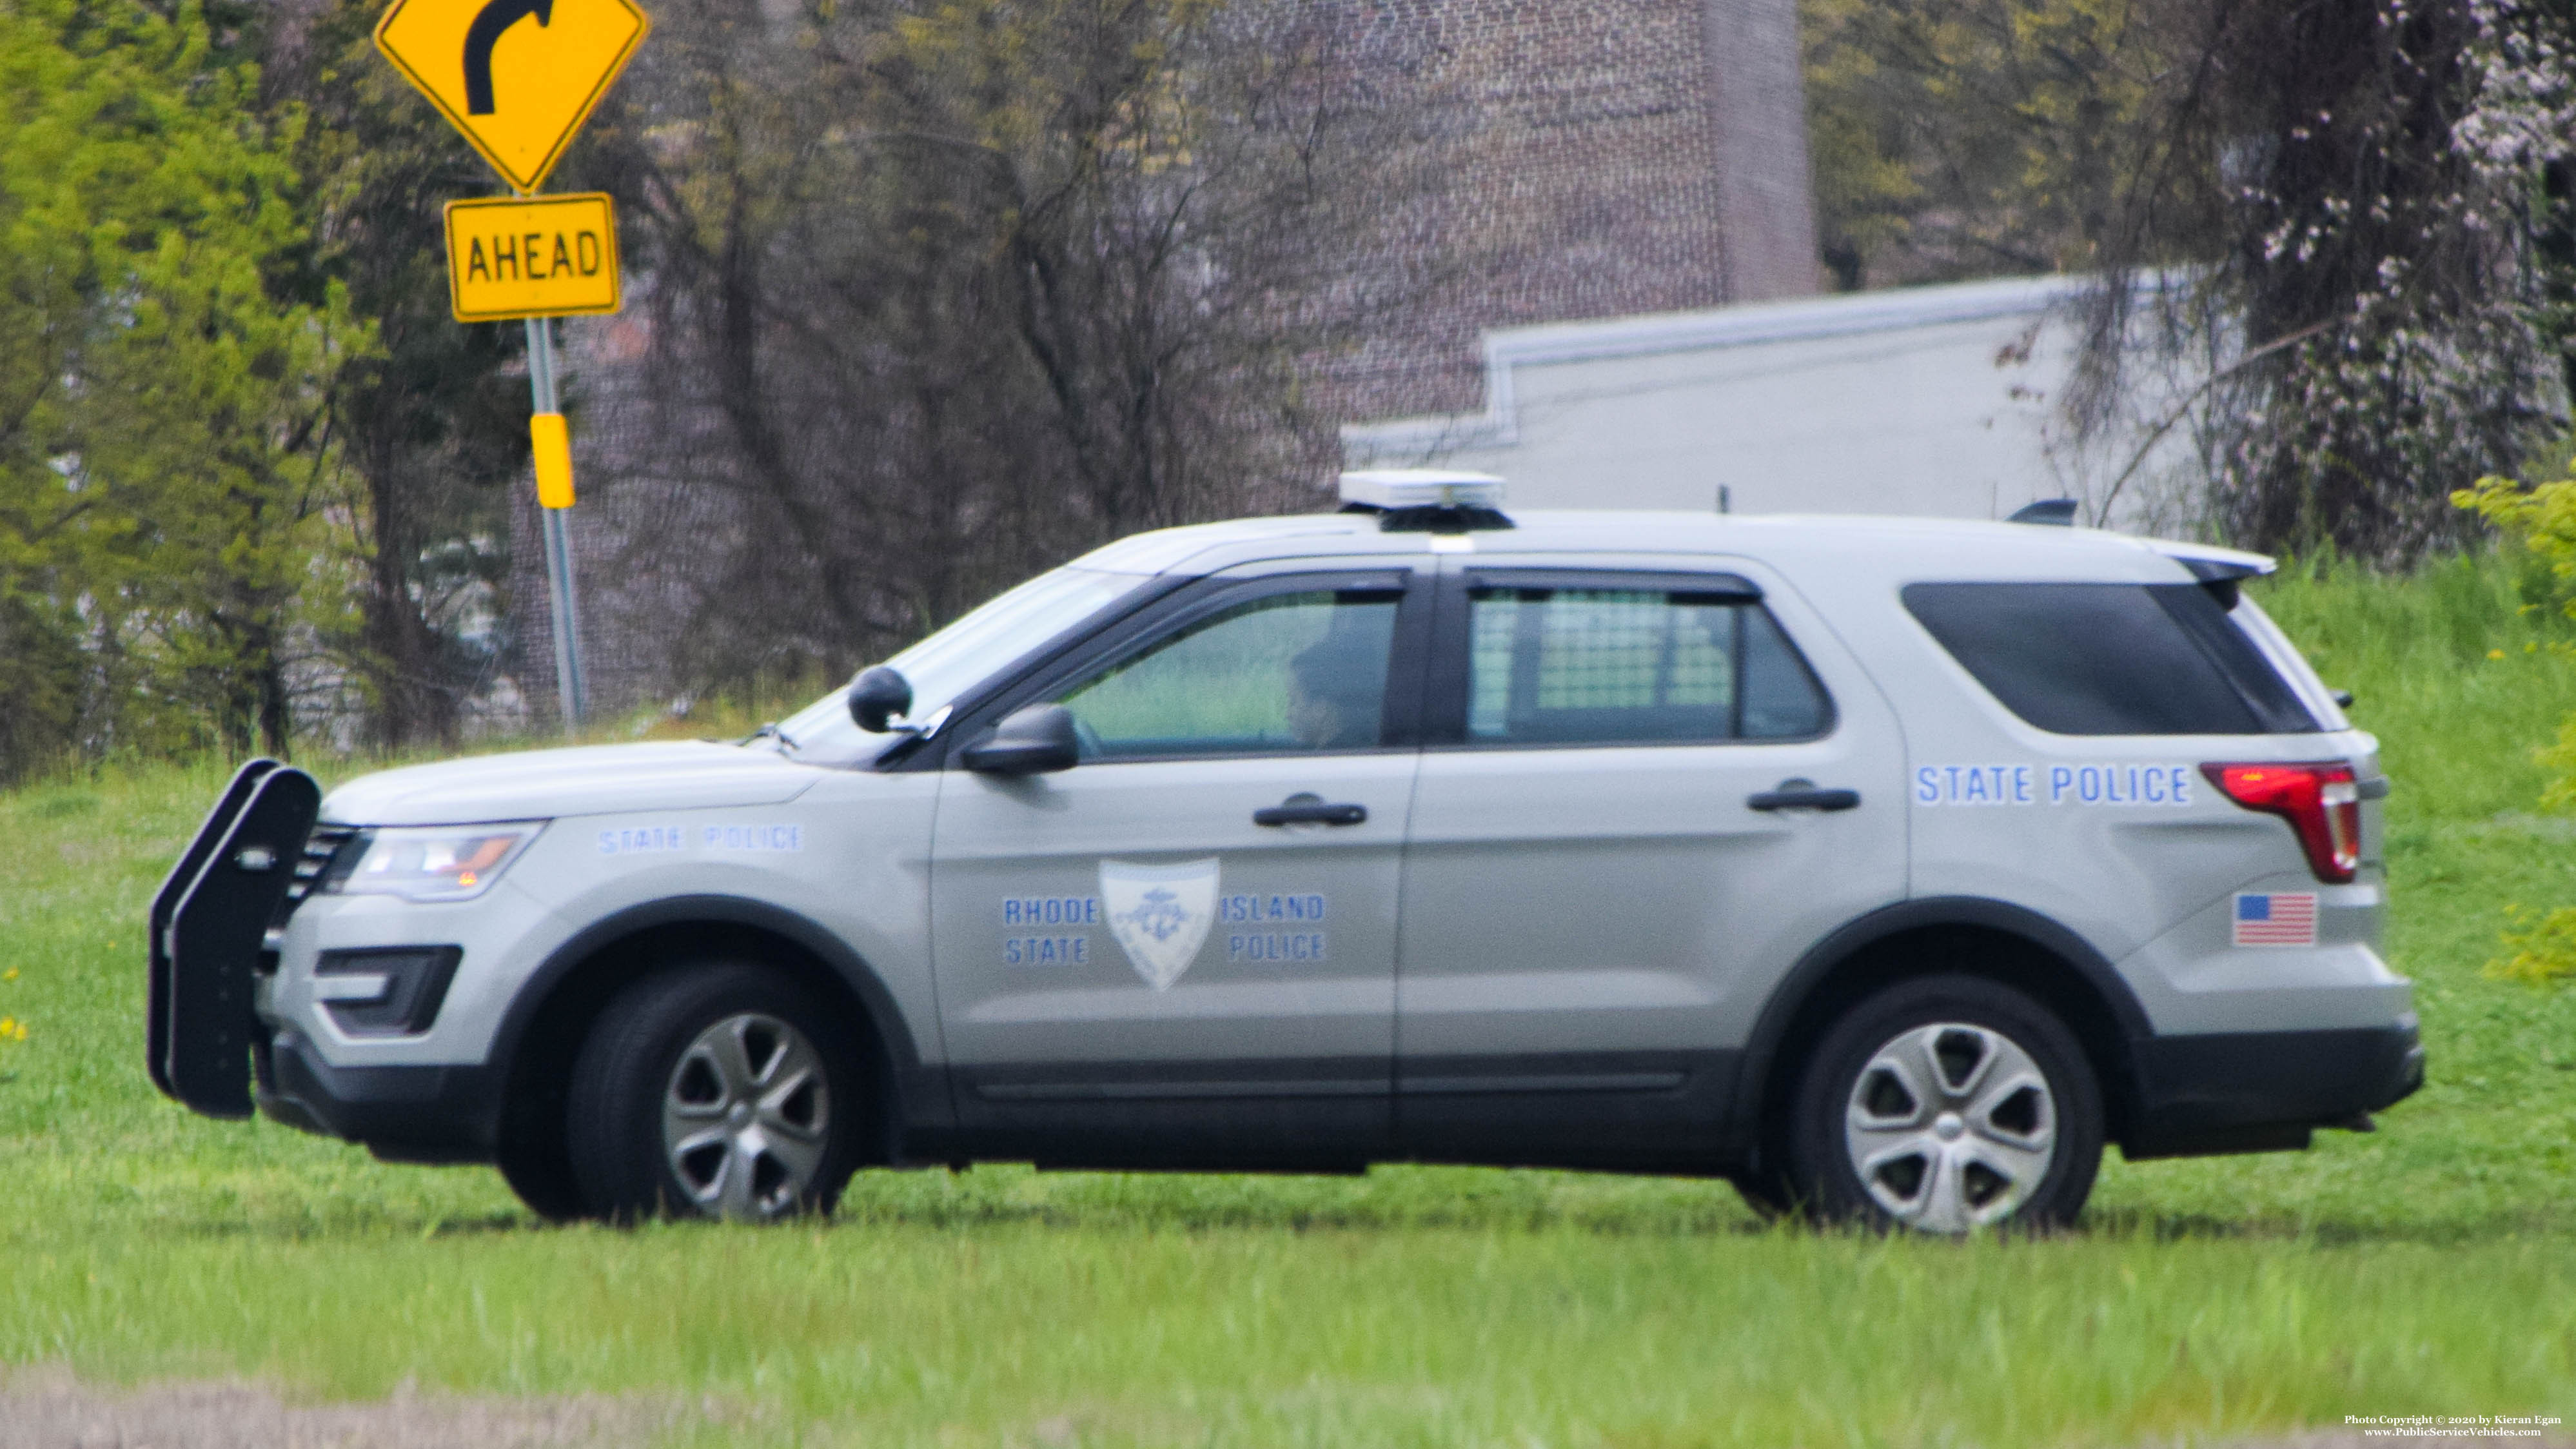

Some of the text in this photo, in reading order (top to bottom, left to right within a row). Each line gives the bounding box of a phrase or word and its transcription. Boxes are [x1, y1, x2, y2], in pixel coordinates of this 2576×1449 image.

[467, 231, 600, 283] AHEAD
[1918, 766, 2188, 803] STATE POLICE
[598, 825, 801, 853] STATE POLICE
[1005, 894, 1324, 925] RHODE ISLAND
[1006, 934, 1324, 963] STATE POLICE
